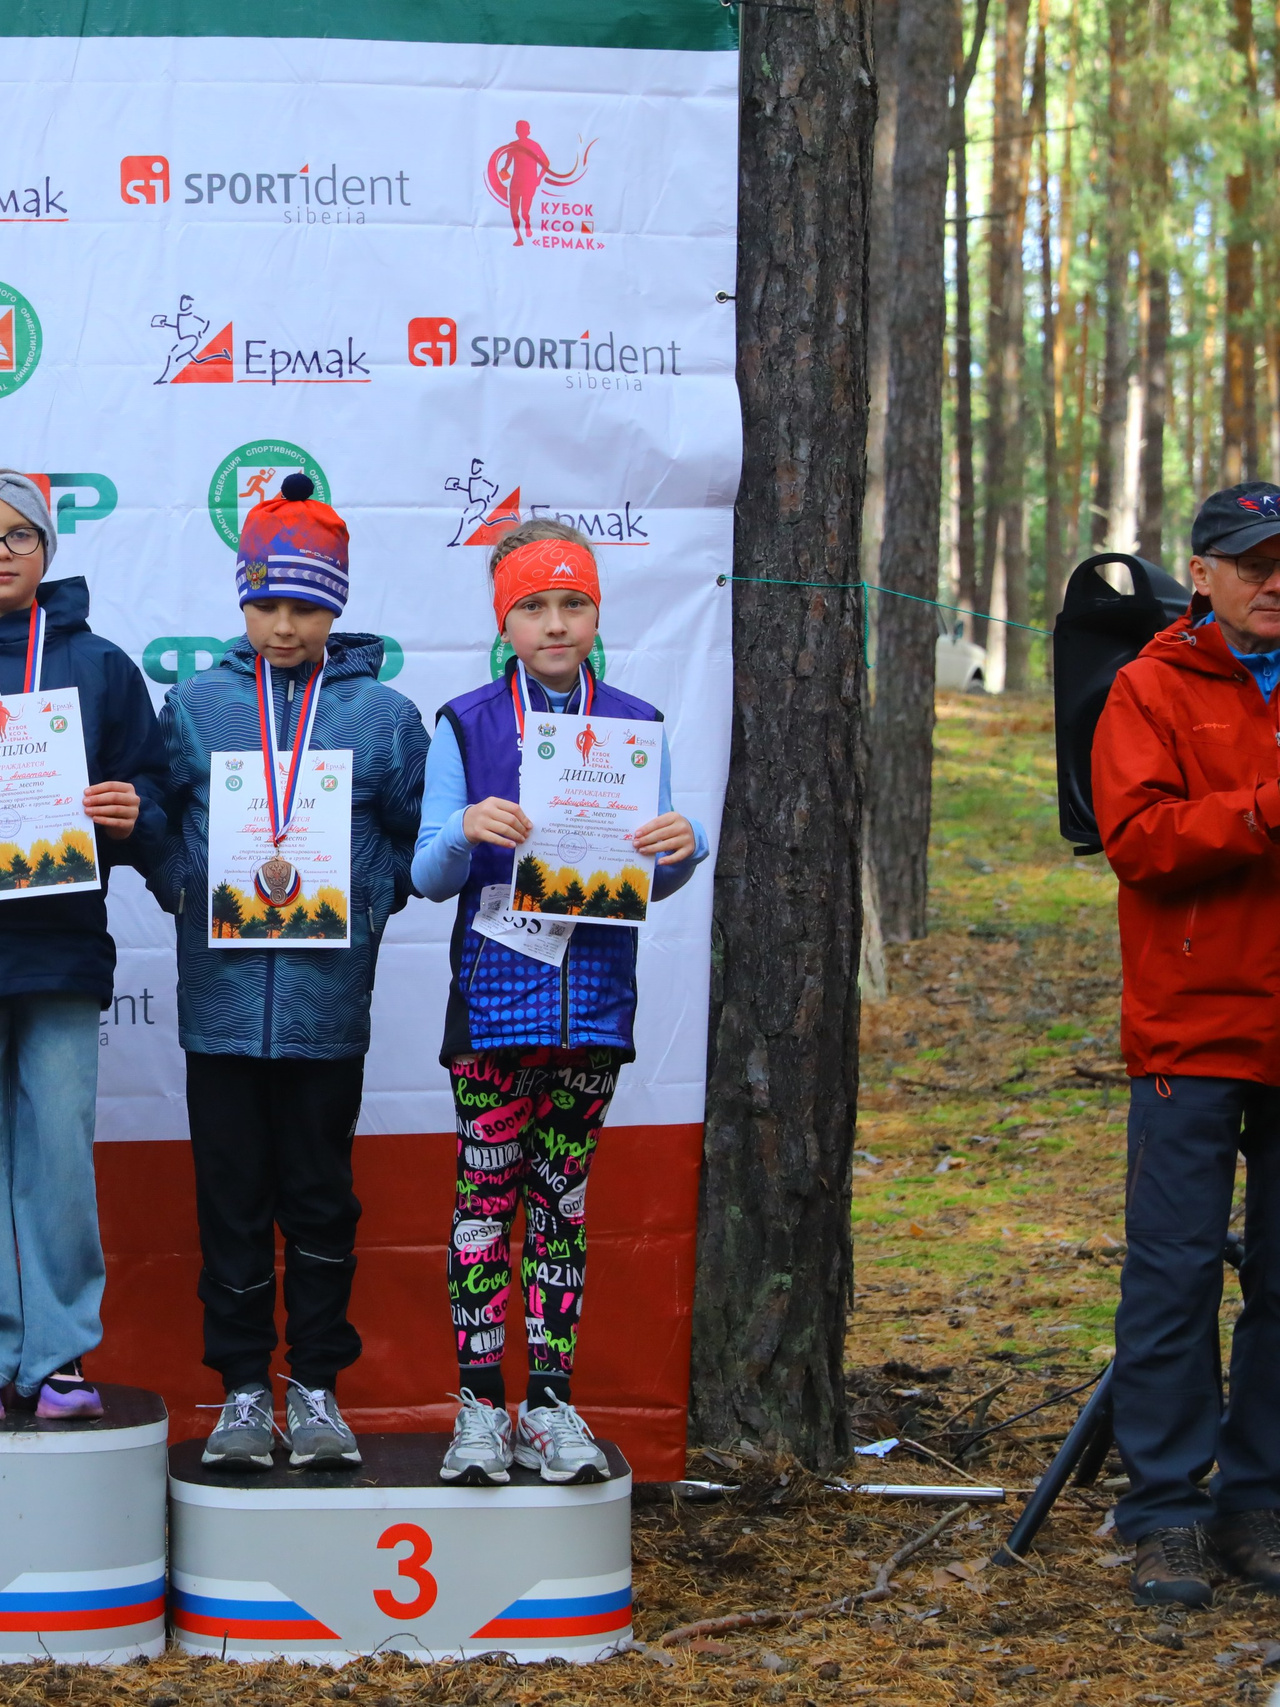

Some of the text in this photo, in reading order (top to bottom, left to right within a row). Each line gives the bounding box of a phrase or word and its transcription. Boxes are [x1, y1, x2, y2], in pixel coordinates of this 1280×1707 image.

[184, 163, 411, 206] SPORTident
[283, 207, 366, 224] siberia
[541, 202, 594, 217] КУБОК
[541, 219, 574, 232] КСО
[532, 236, 605, 250] «ЕРМАК»
[13, 307, 37, 382] ОРИЕНТИРОВАНИЯ
[470, 330, 682, 376] SPORTident
[245, 336, 370, 386] Ермак
[566, 372, 643, 391] siberia
[245, 446, 306, 464] СПОРТИВНОГО
[214, 456, 241, 502] ФЕДЕРАЦИЯ
[215, 508, 238, 544] ОБЛАСТИ
[636, 738, 656, 746] Ермак
[559, 769, 626, 785] ДИПЛОМ
[564, 788, 620, 798] НАГРАЖДАЕТСЯ
[247, 799, 315, 811] ДИОМ
[456, 1077, 502, 1108] love
[454, 1238, 509, 1266] with
[462, 1264, 510, 1294] love
[373, 1523, 438, 1620] 3
